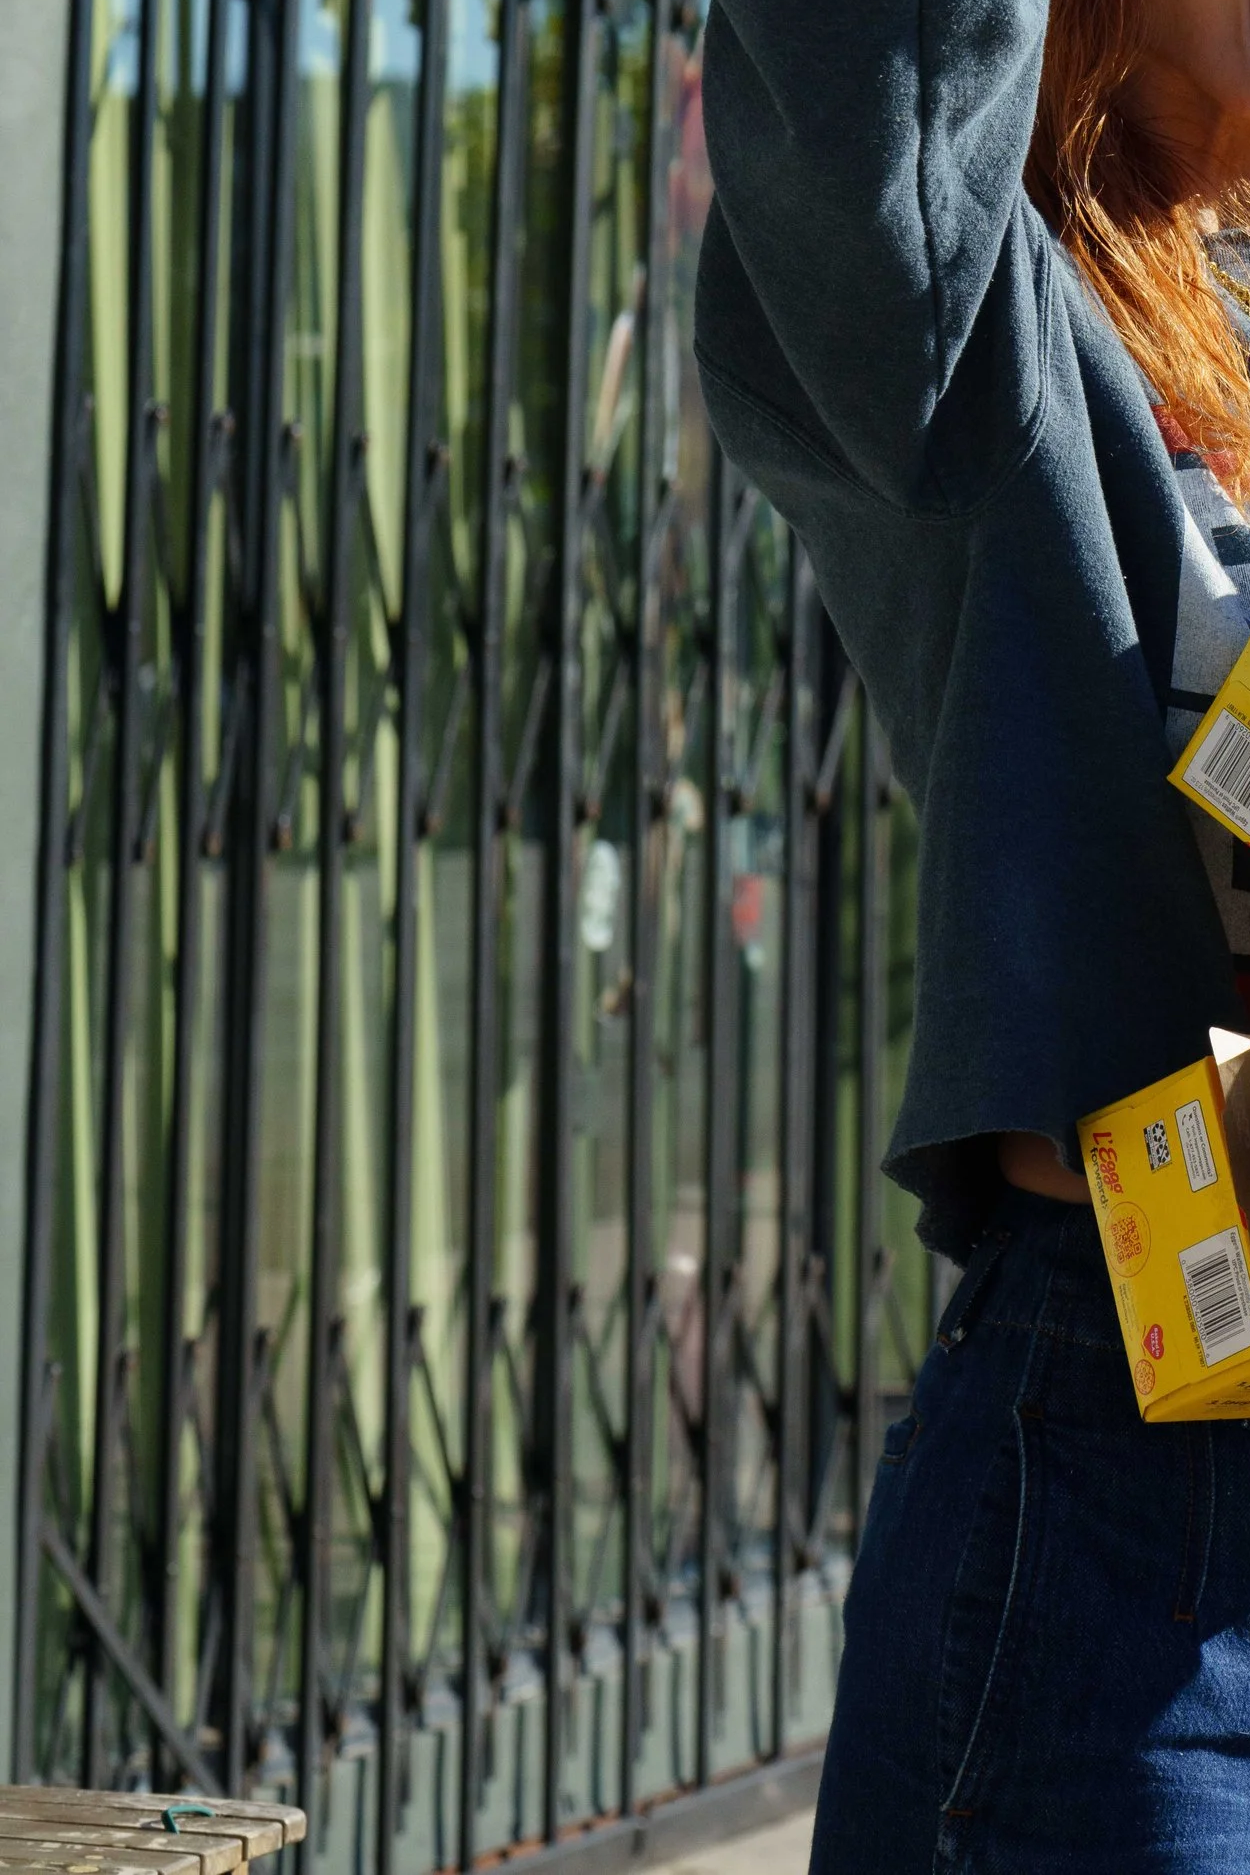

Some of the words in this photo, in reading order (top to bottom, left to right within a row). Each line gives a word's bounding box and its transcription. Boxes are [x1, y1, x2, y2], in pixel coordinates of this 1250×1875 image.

[1194, 780, 1204, 790] 12.3
[1203, 779, 1219, 794] Purchase
[1220, 801, 1236, 816] Waffles
[1221, 794, 1232, 805] Proof
[1231, 802, 1240, 811] UPC
[1191, 1105, 1202, 1135] Questions
[1200, 1142, 1212, 1177] Comments?
[1092, 1132, 1123, 1193] L'Eggo
[1088, 1146, 1108, 1203] forward
[1234, 1251, 1244, 1273] Waffles
[1233, 1271, 1241, 1286] Proof
[1238, 1293, 1248, 1316] Purchase
[1185, 1278, 1197, 1307] 38000
[1193, 1310, 1206, 1340] 40500
[1148, 1331, 1156, 1353] U.S.A.
[1152, 1326, 1160, 1346] Baked
